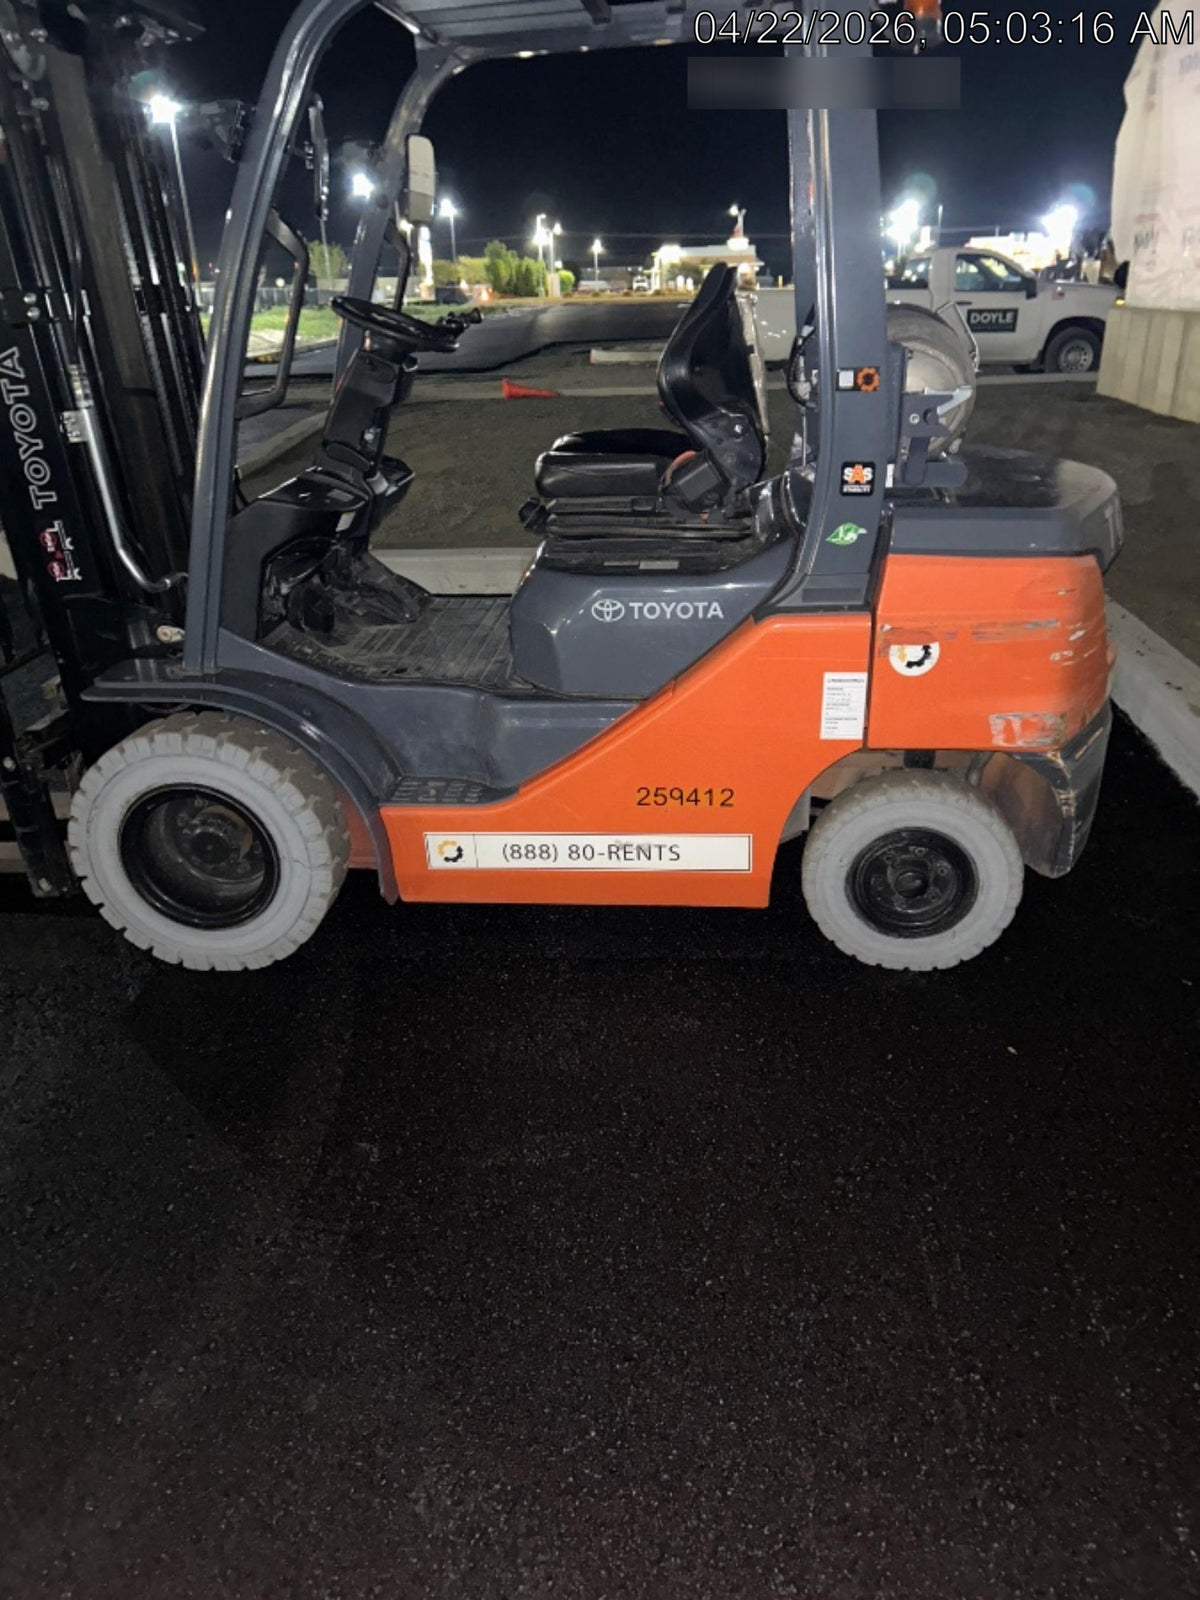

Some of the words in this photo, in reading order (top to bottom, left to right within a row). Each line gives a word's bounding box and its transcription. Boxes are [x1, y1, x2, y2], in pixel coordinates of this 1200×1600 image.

[970, 312, 1014, 324] DOYLE
[0, 347, 57, 510] TOYOTA
[843, 464, 873, 484] SAS
[628, 601, 725, 619] TOYOTA
[636, 787, 735, 807] 259412
[502, 842, 559, 863] (888)
[567, 842, 681, 863] 80-RENTS
